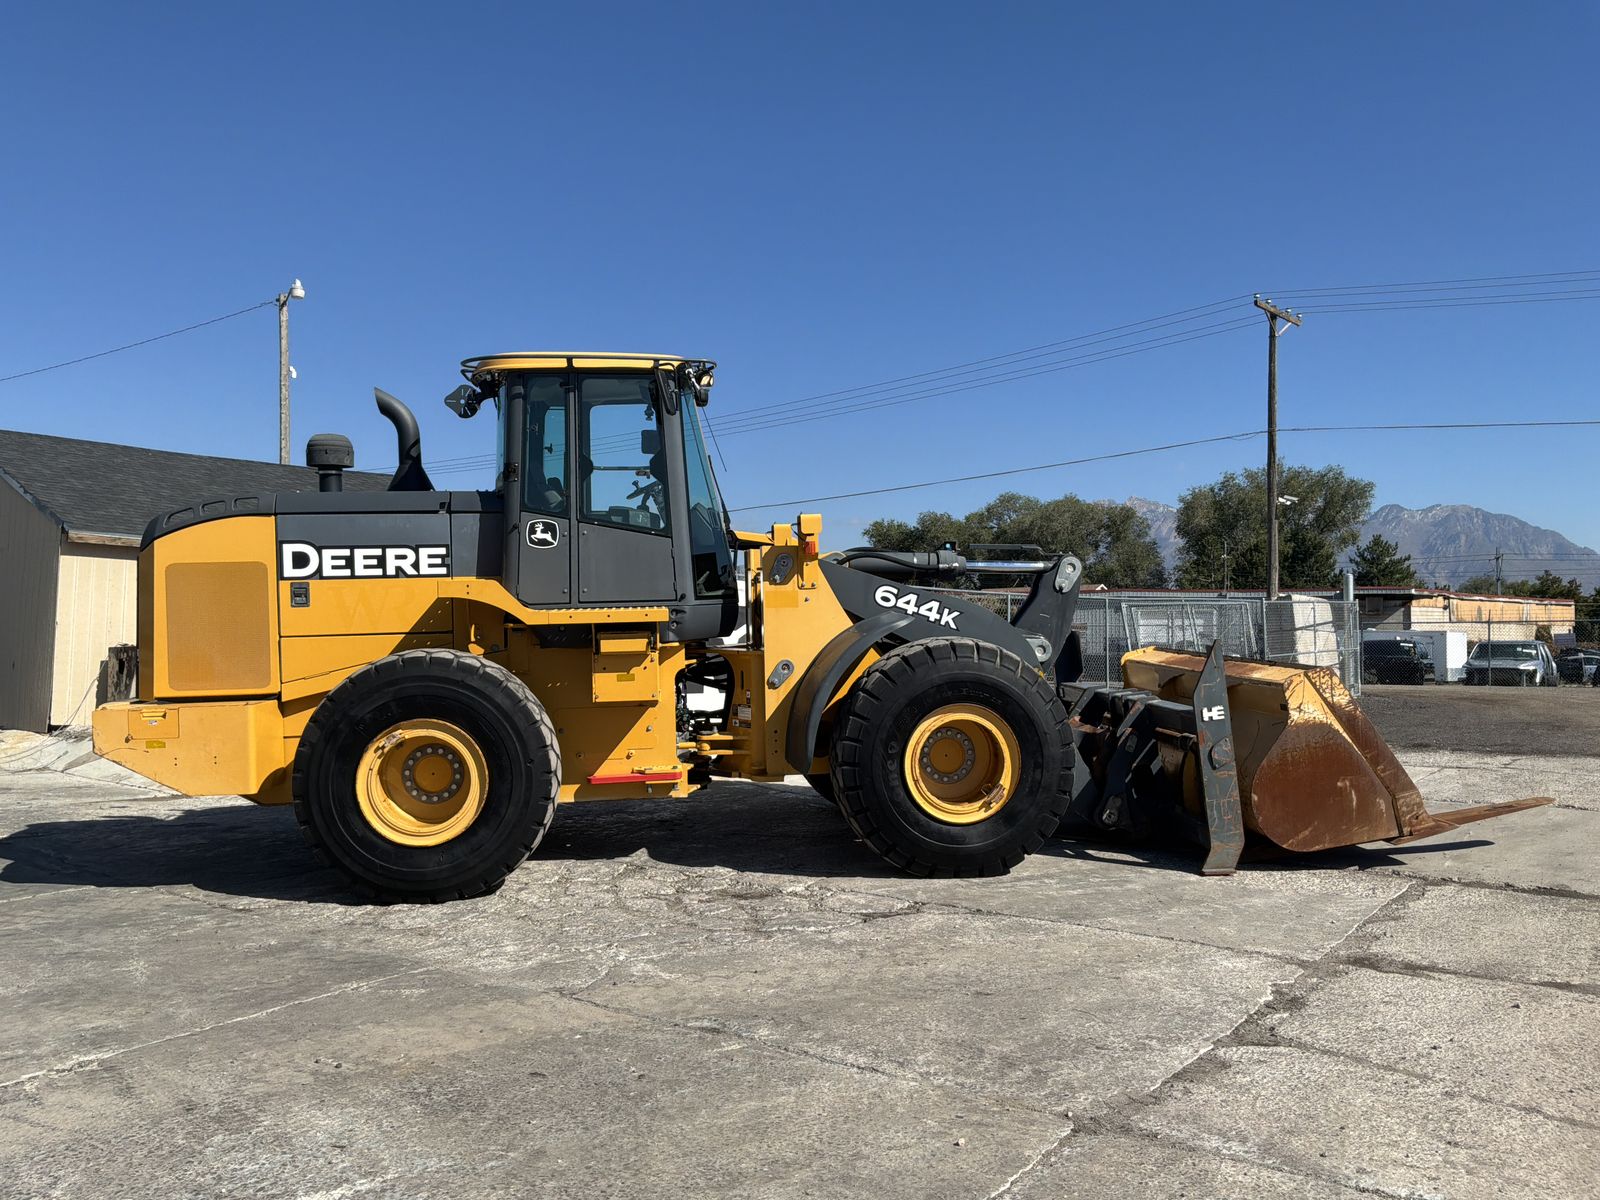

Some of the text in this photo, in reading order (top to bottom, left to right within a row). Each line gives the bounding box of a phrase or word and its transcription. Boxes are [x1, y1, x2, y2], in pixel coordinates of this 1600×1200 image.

[282, 543, 448, 578] DEERE
[875, 585, 960, 630] 644K
[1202, 705, 1225, 721] HE
